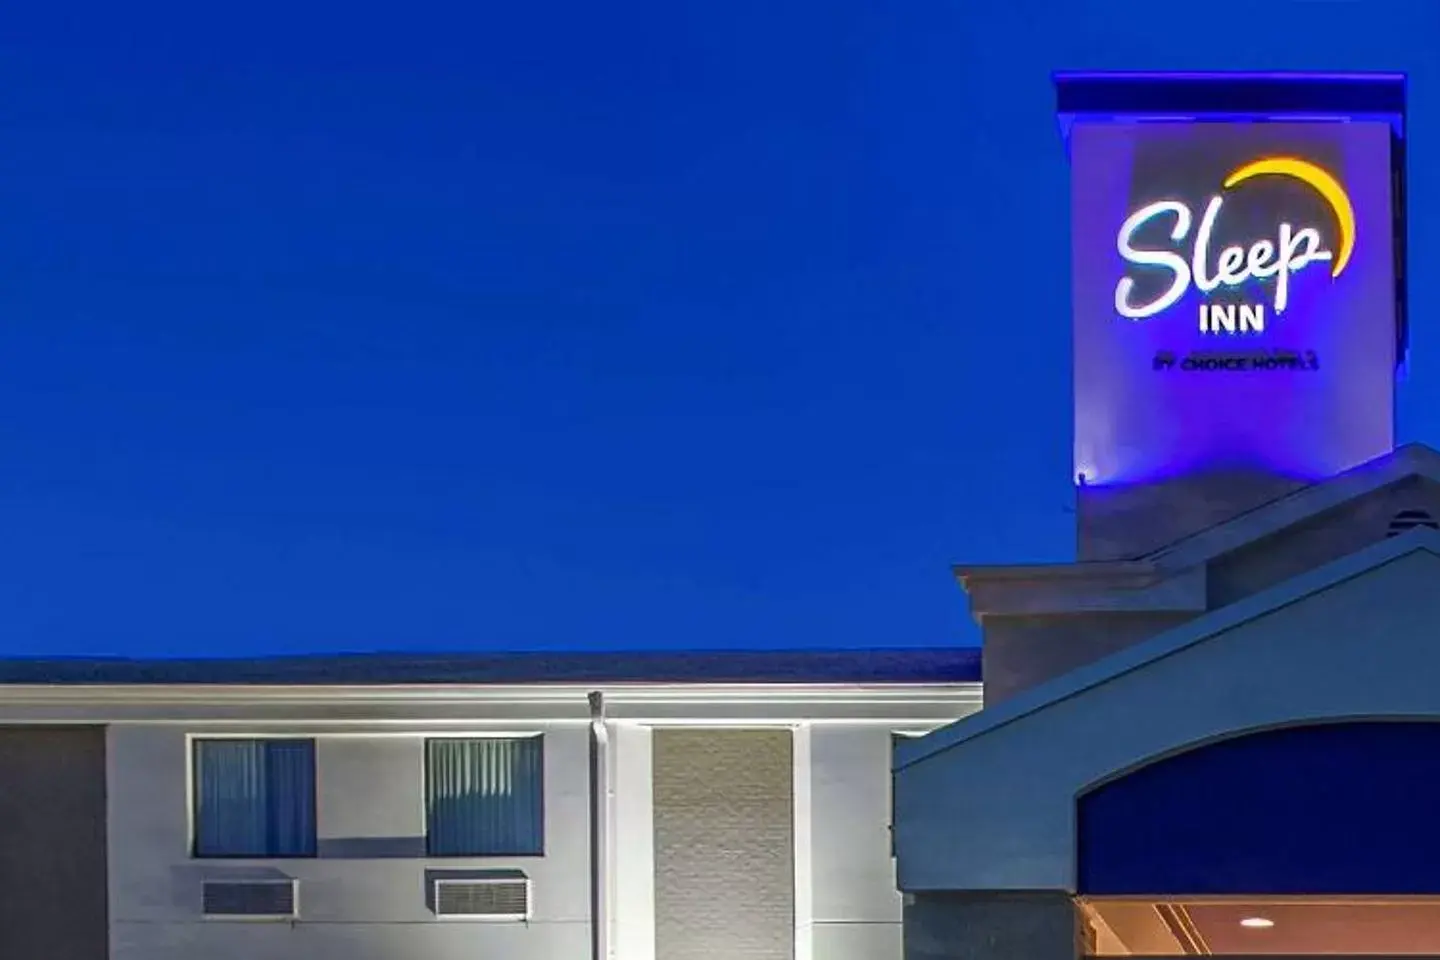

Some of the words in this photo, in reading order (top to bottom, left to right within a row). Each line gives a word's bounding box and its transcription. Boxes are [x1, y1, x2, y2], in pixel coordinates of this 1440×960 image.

[1115, 195, 1333, 318] Sleep
[1199, 304, 1265, 334] INN
[1152, 354, 1175, 372] BY
[1180, 356, 1248, 372] CHOICE
[1252, 354, 1320, 372] HOTELS
